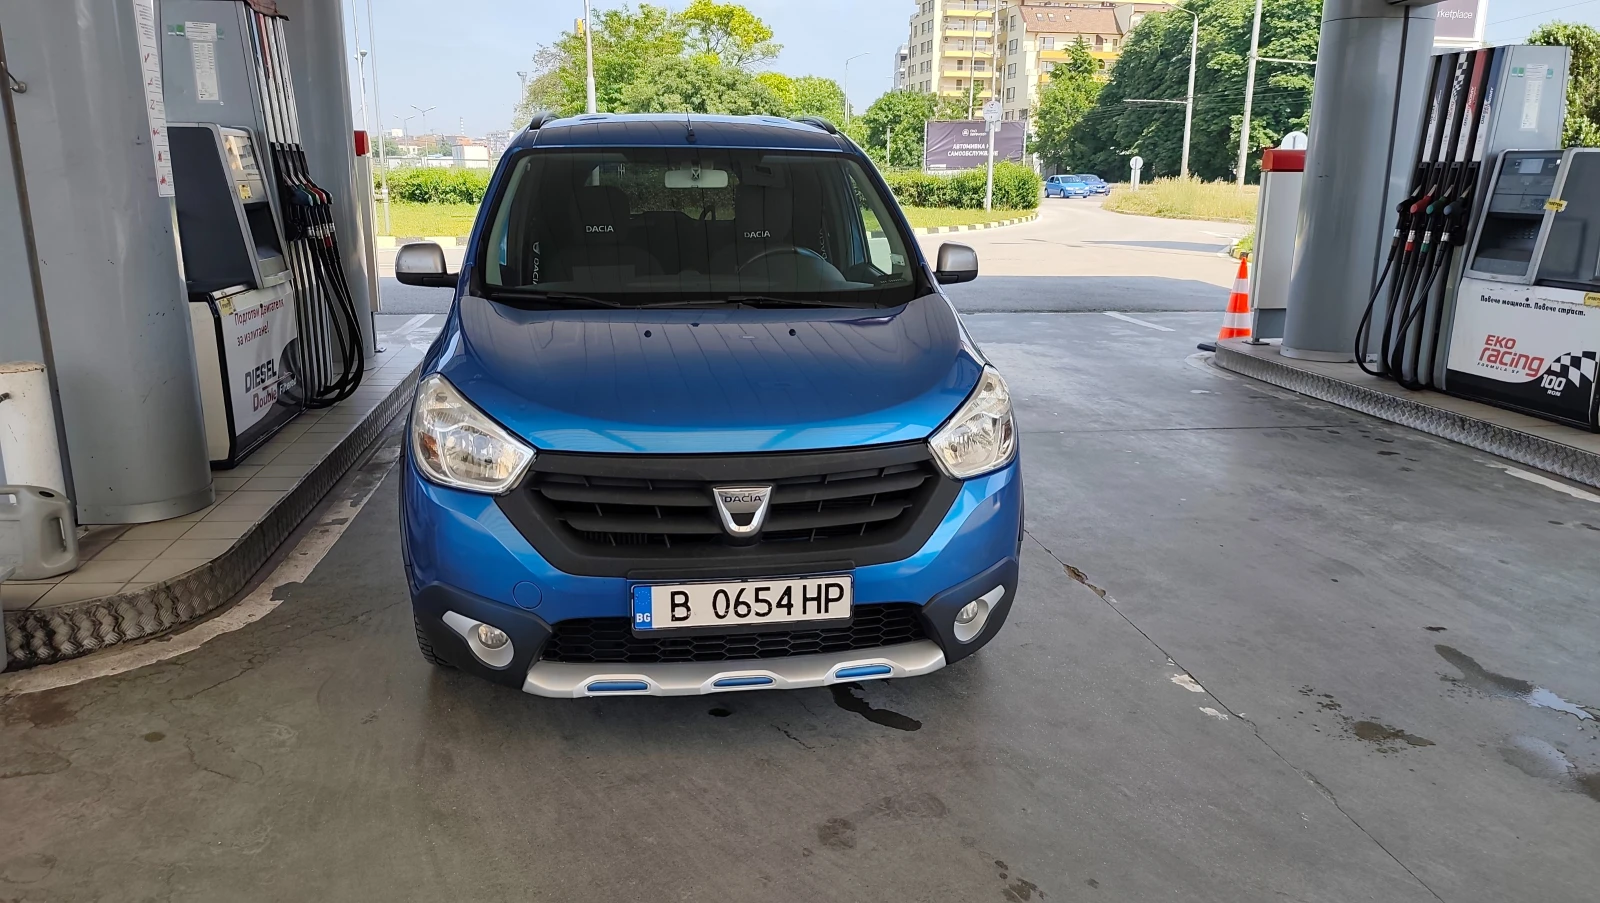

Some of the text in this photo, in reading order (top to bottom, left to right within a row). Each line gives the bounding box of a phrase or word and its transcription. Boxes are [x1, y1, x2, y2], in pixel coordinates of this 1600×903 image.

[1437, 9, 1473, 20] rketplace
[585, 225, 614, 233] DACIA
[743, 230, 771, 239] DACIA
[1480, 295, 1501, 305] Повече
[1533, 302, 1557, 312] Повече
[1557, 307, 1586, 316] страст.
[237, 321, 269, 346] за излитане!
[1485, 335, 1516, 349] EKO
[1477, 362, 1507, 371] FORMULA
[1479, 347, 1544, 377] racing
[245, 358, 277, 393] DIESEL
[1541, 374, 1566, 391] 100
[253, 388, 277, 412] Double
[724, 494, 762, 503] DACIA
[670, 582, 845, 622] B 0654 HP
[636, 612, 651, 623] BG
